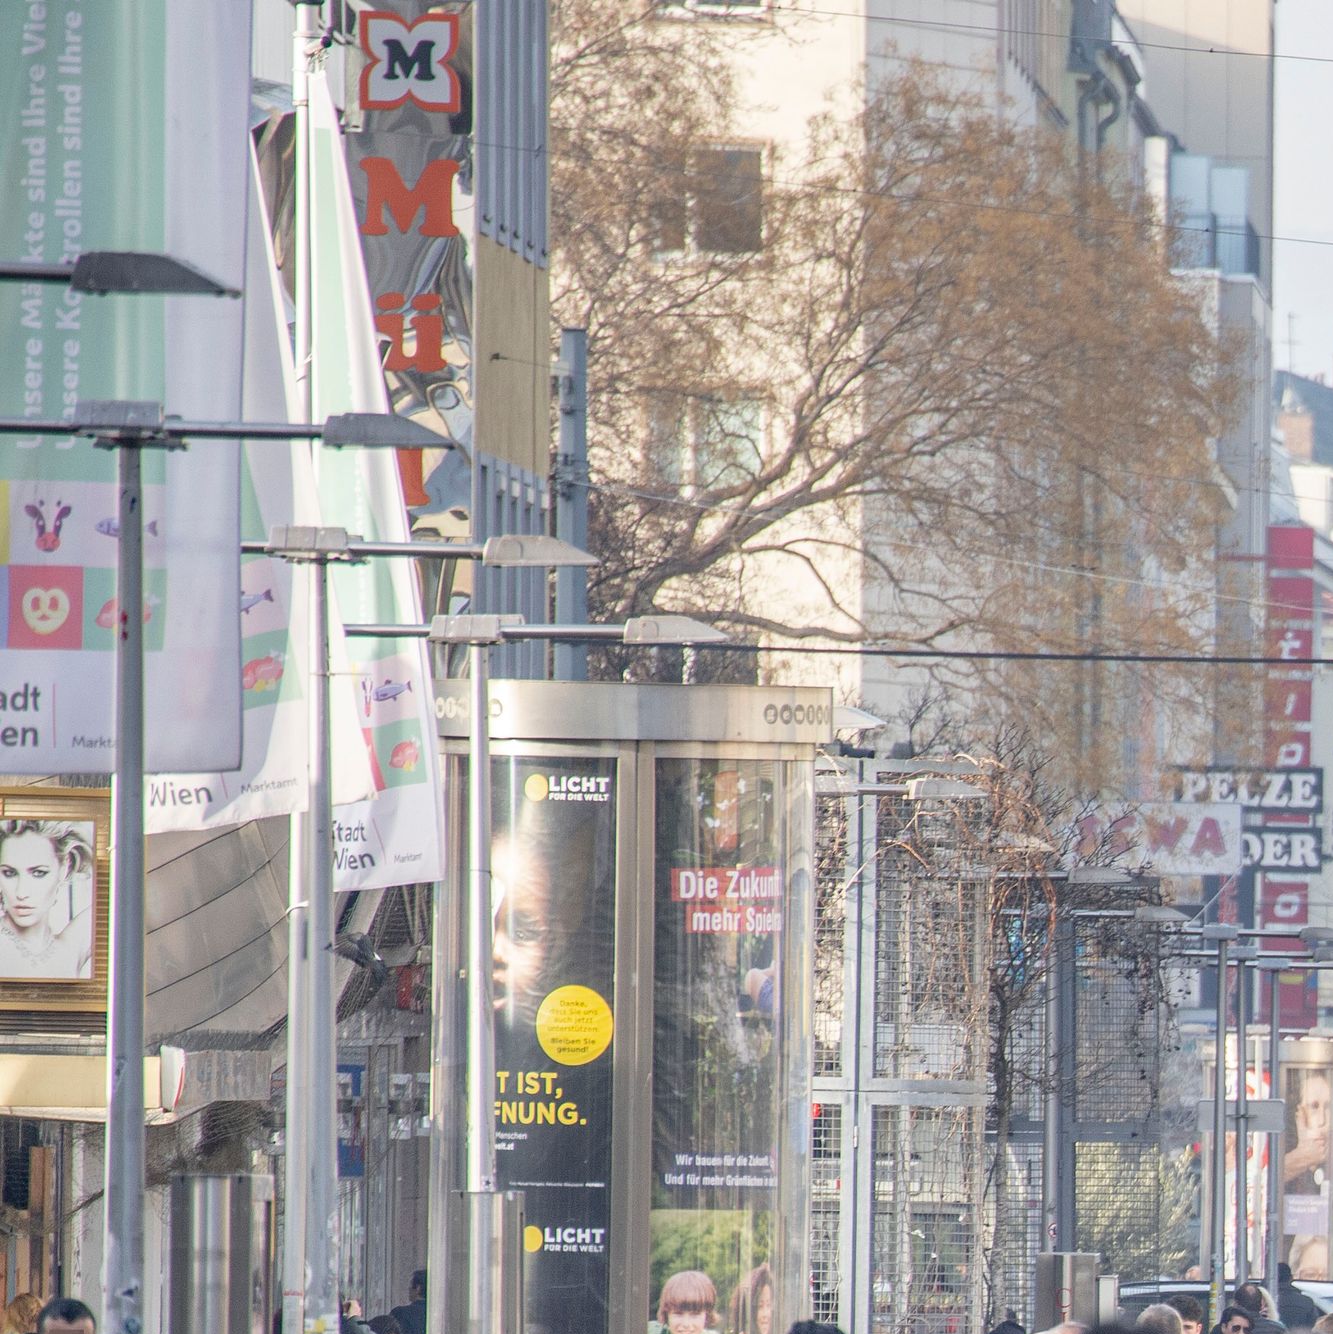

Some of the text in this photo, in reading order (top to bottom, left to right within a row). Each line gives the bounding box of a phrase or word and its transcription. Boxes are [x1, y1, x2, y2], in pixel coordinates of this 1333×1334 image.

[22, 0, 47, 56] Vie
[57, 10, 82, 75] Ihre
[383, 39, 436, 81] M
[21, 63, 46, 127] Ihre
[57, 84, 82, 150] sind
[21, 137, 46, 203] sind
[55, 160, 82, 330] Kotrollen
[21, 211, 45, 329] Mäkte
[149, 782, 214, 807] Wien
[240, 779, 299, 795] Marktamt
[548, 775, 610, 793] LICHT
[567, 793, 583, 802] DIE
[584, 793, 610, 802] WELT
[679, 870, 719, 899] Die
[692, 906, 741, 932] mehr
[583, 1038, 597, 1046] Sie
[517, 1072, 564, 1099] IST,
[675, 1154, 693, 1166] Wir
[664, 1174, 684, 1185] Und
[686, 1175, 700, 1186] für
[702, 1176, 724, 1186] mehr
[543, 1227, 605, 1244] LICHT
[543, 1244, 605, 1253] FÜR DIE WELT
